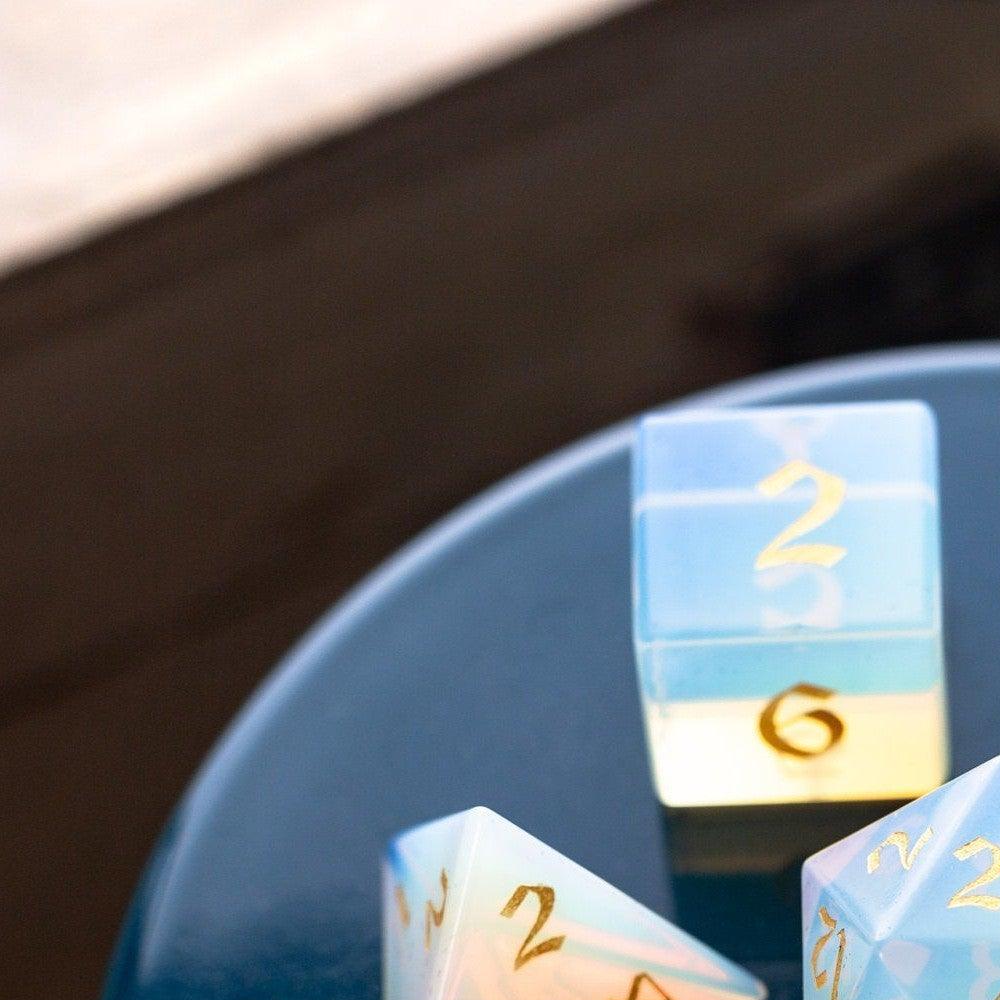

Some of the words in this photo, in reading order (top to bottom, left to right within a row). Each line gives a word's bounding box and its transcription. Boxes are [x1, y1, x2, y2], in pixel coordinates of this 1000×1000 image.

[755, 459, 848, 570] 2
[759, 681, 844, 761] 6
[867, 826, 934, 873] 2
[500, 885, 566, 971] 2
